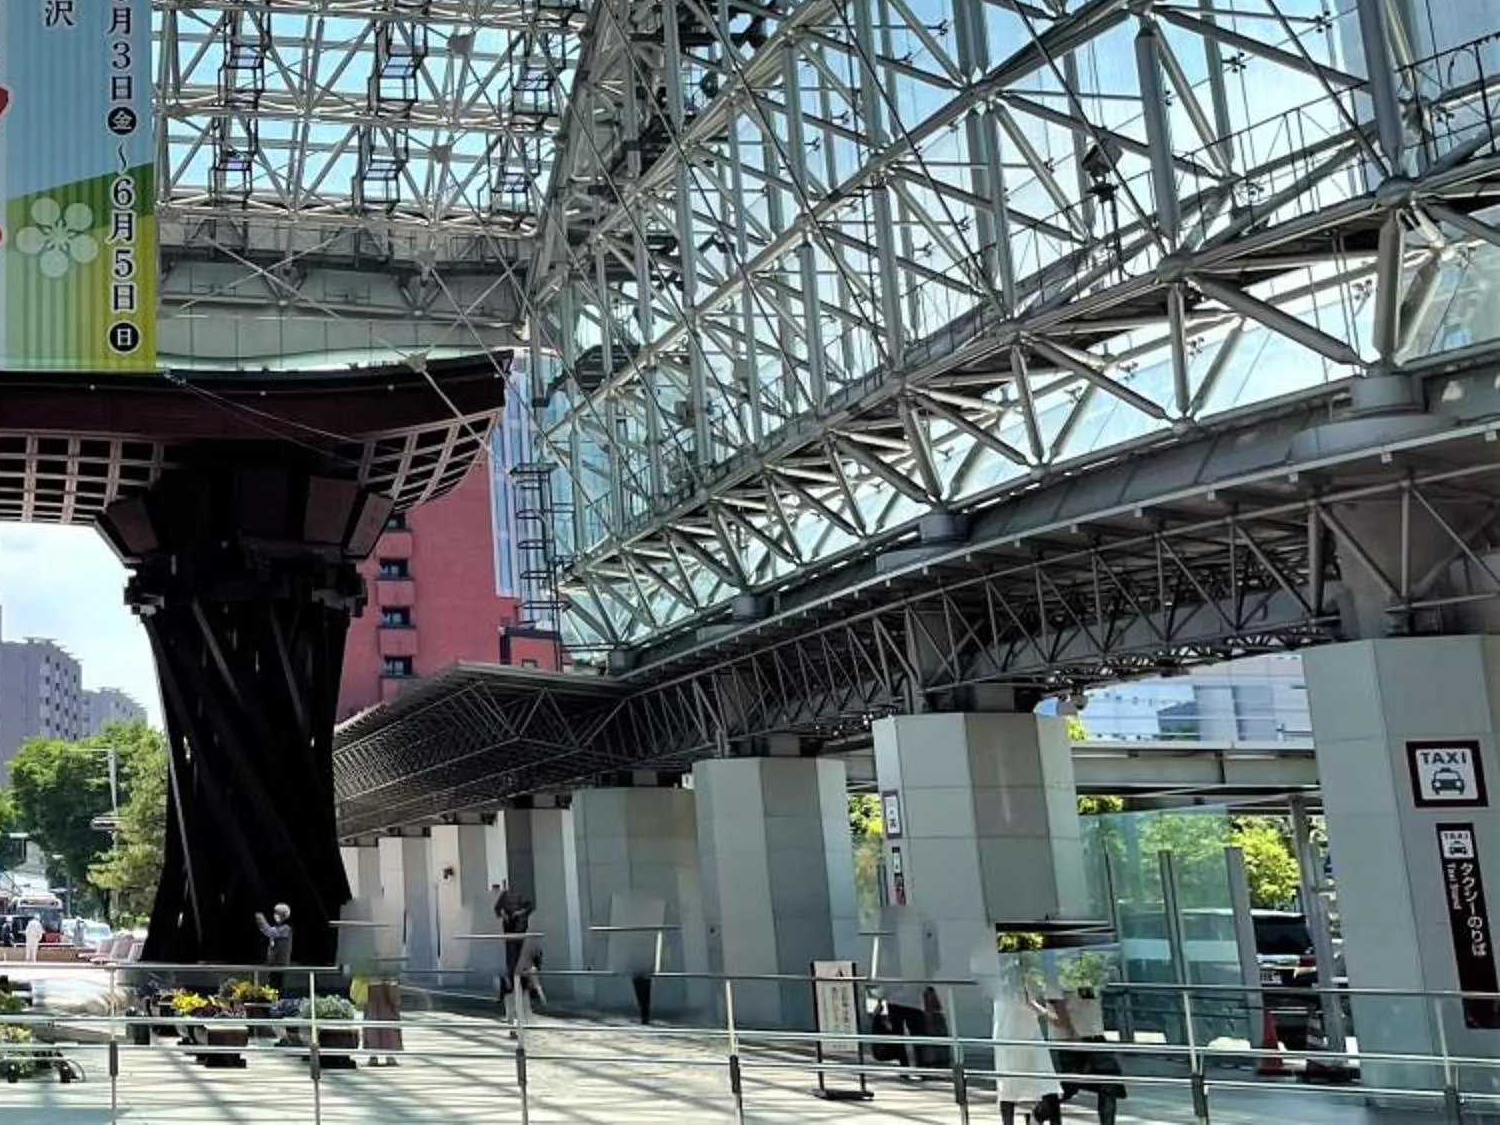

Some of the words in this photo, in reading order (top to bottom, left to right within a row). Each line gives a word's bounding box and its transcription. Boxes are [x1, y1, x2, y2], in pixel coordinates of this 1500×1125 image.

[1420, 751, 1467, 764] TAXI
[1459, 862, 1488, 956] タクシーのりば
